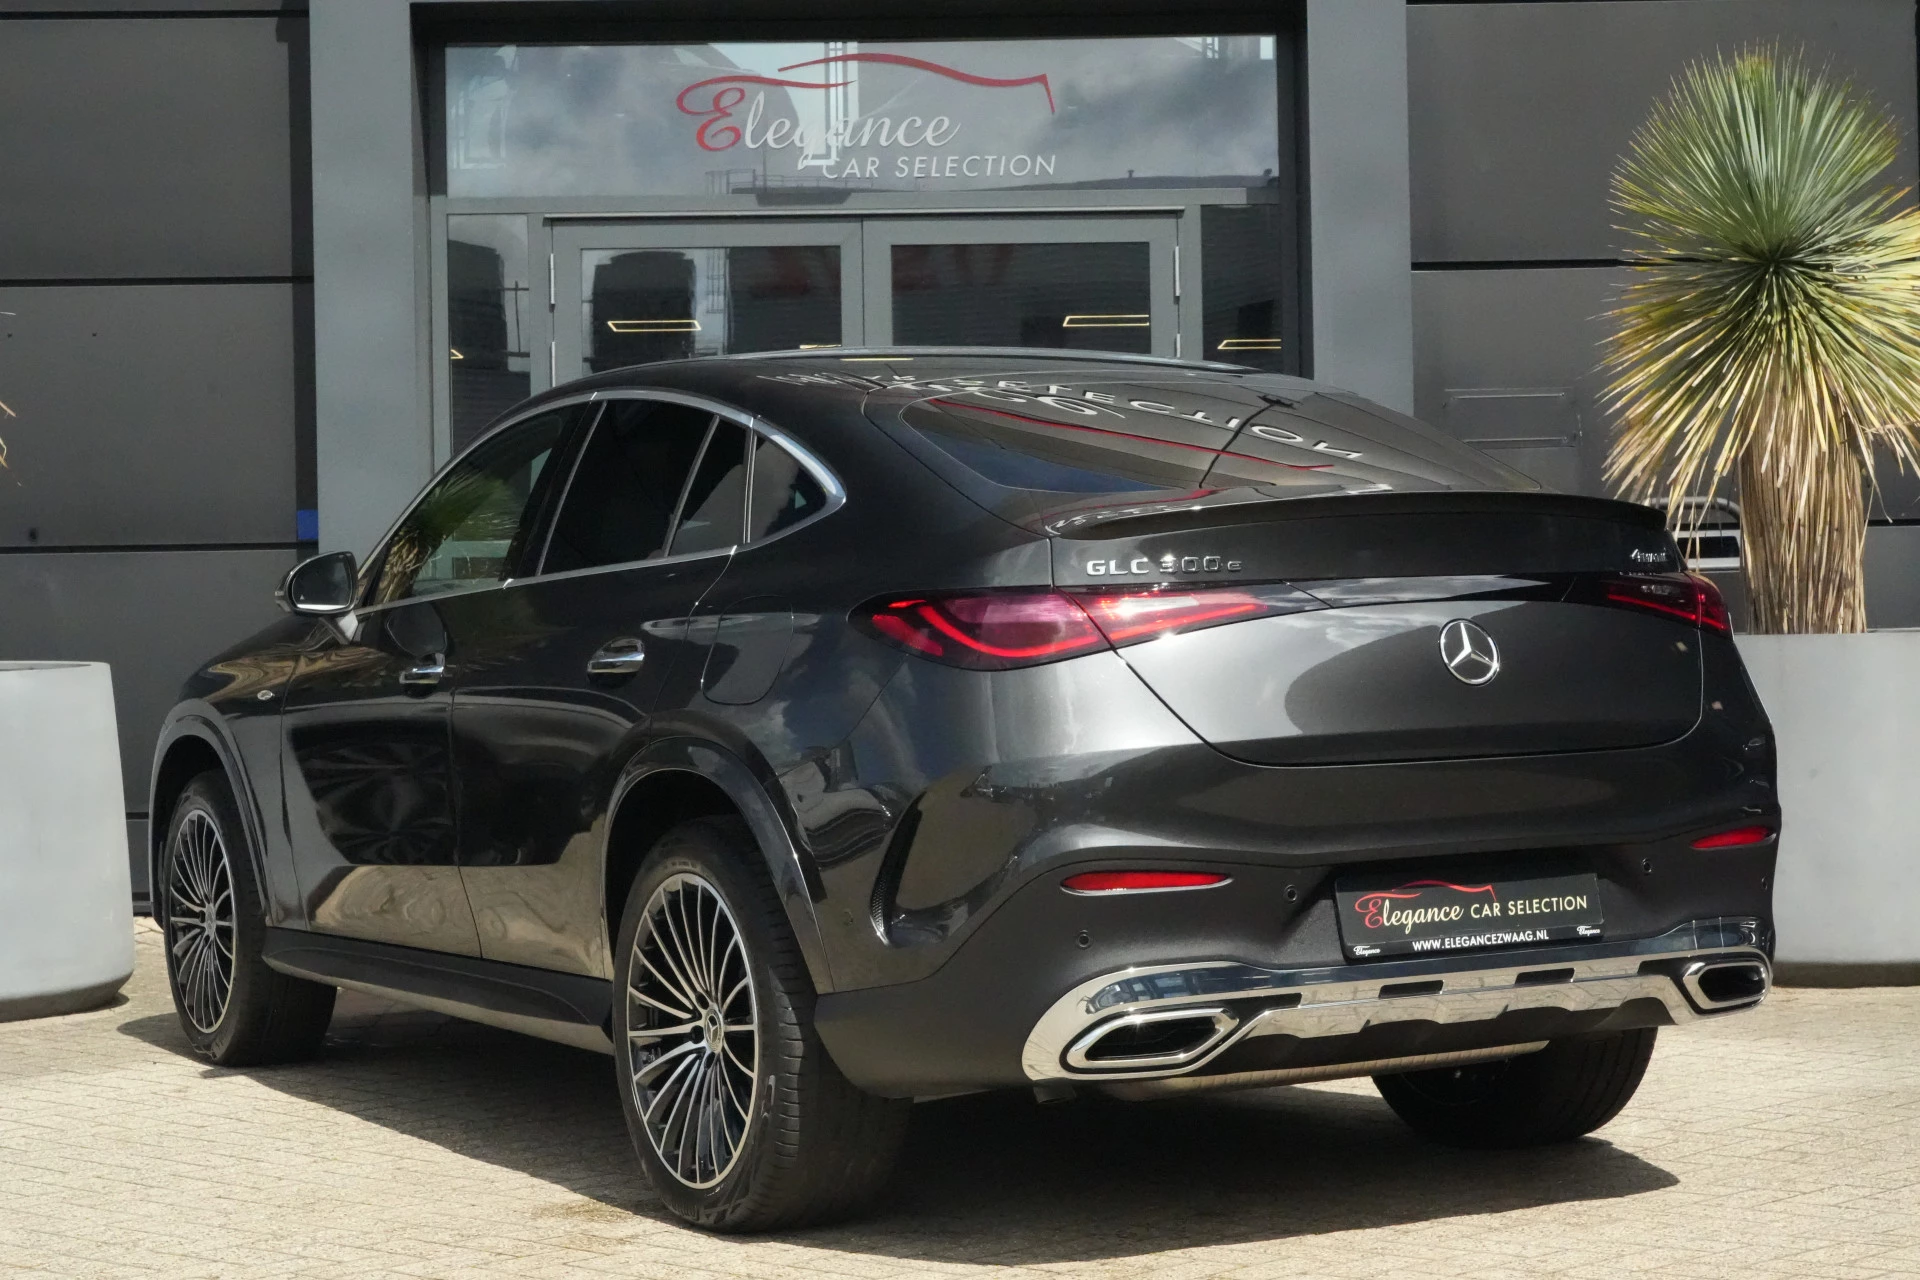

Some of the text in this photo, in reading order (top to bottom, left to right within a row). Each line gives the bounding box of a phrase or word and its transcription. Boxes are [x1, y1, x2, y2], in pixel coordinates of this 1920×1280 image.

[677, 82, 960, 170] Elegance
[822, 154, 1057, 179] CAR SELECTION
[1086, 557, 1150, 576] GLC
[1355, 893, 1588, 934] Elegance CAR SELECTION
[1412, 930, 1549, 951] WWW.ELEGANCEZWAAG.NL
